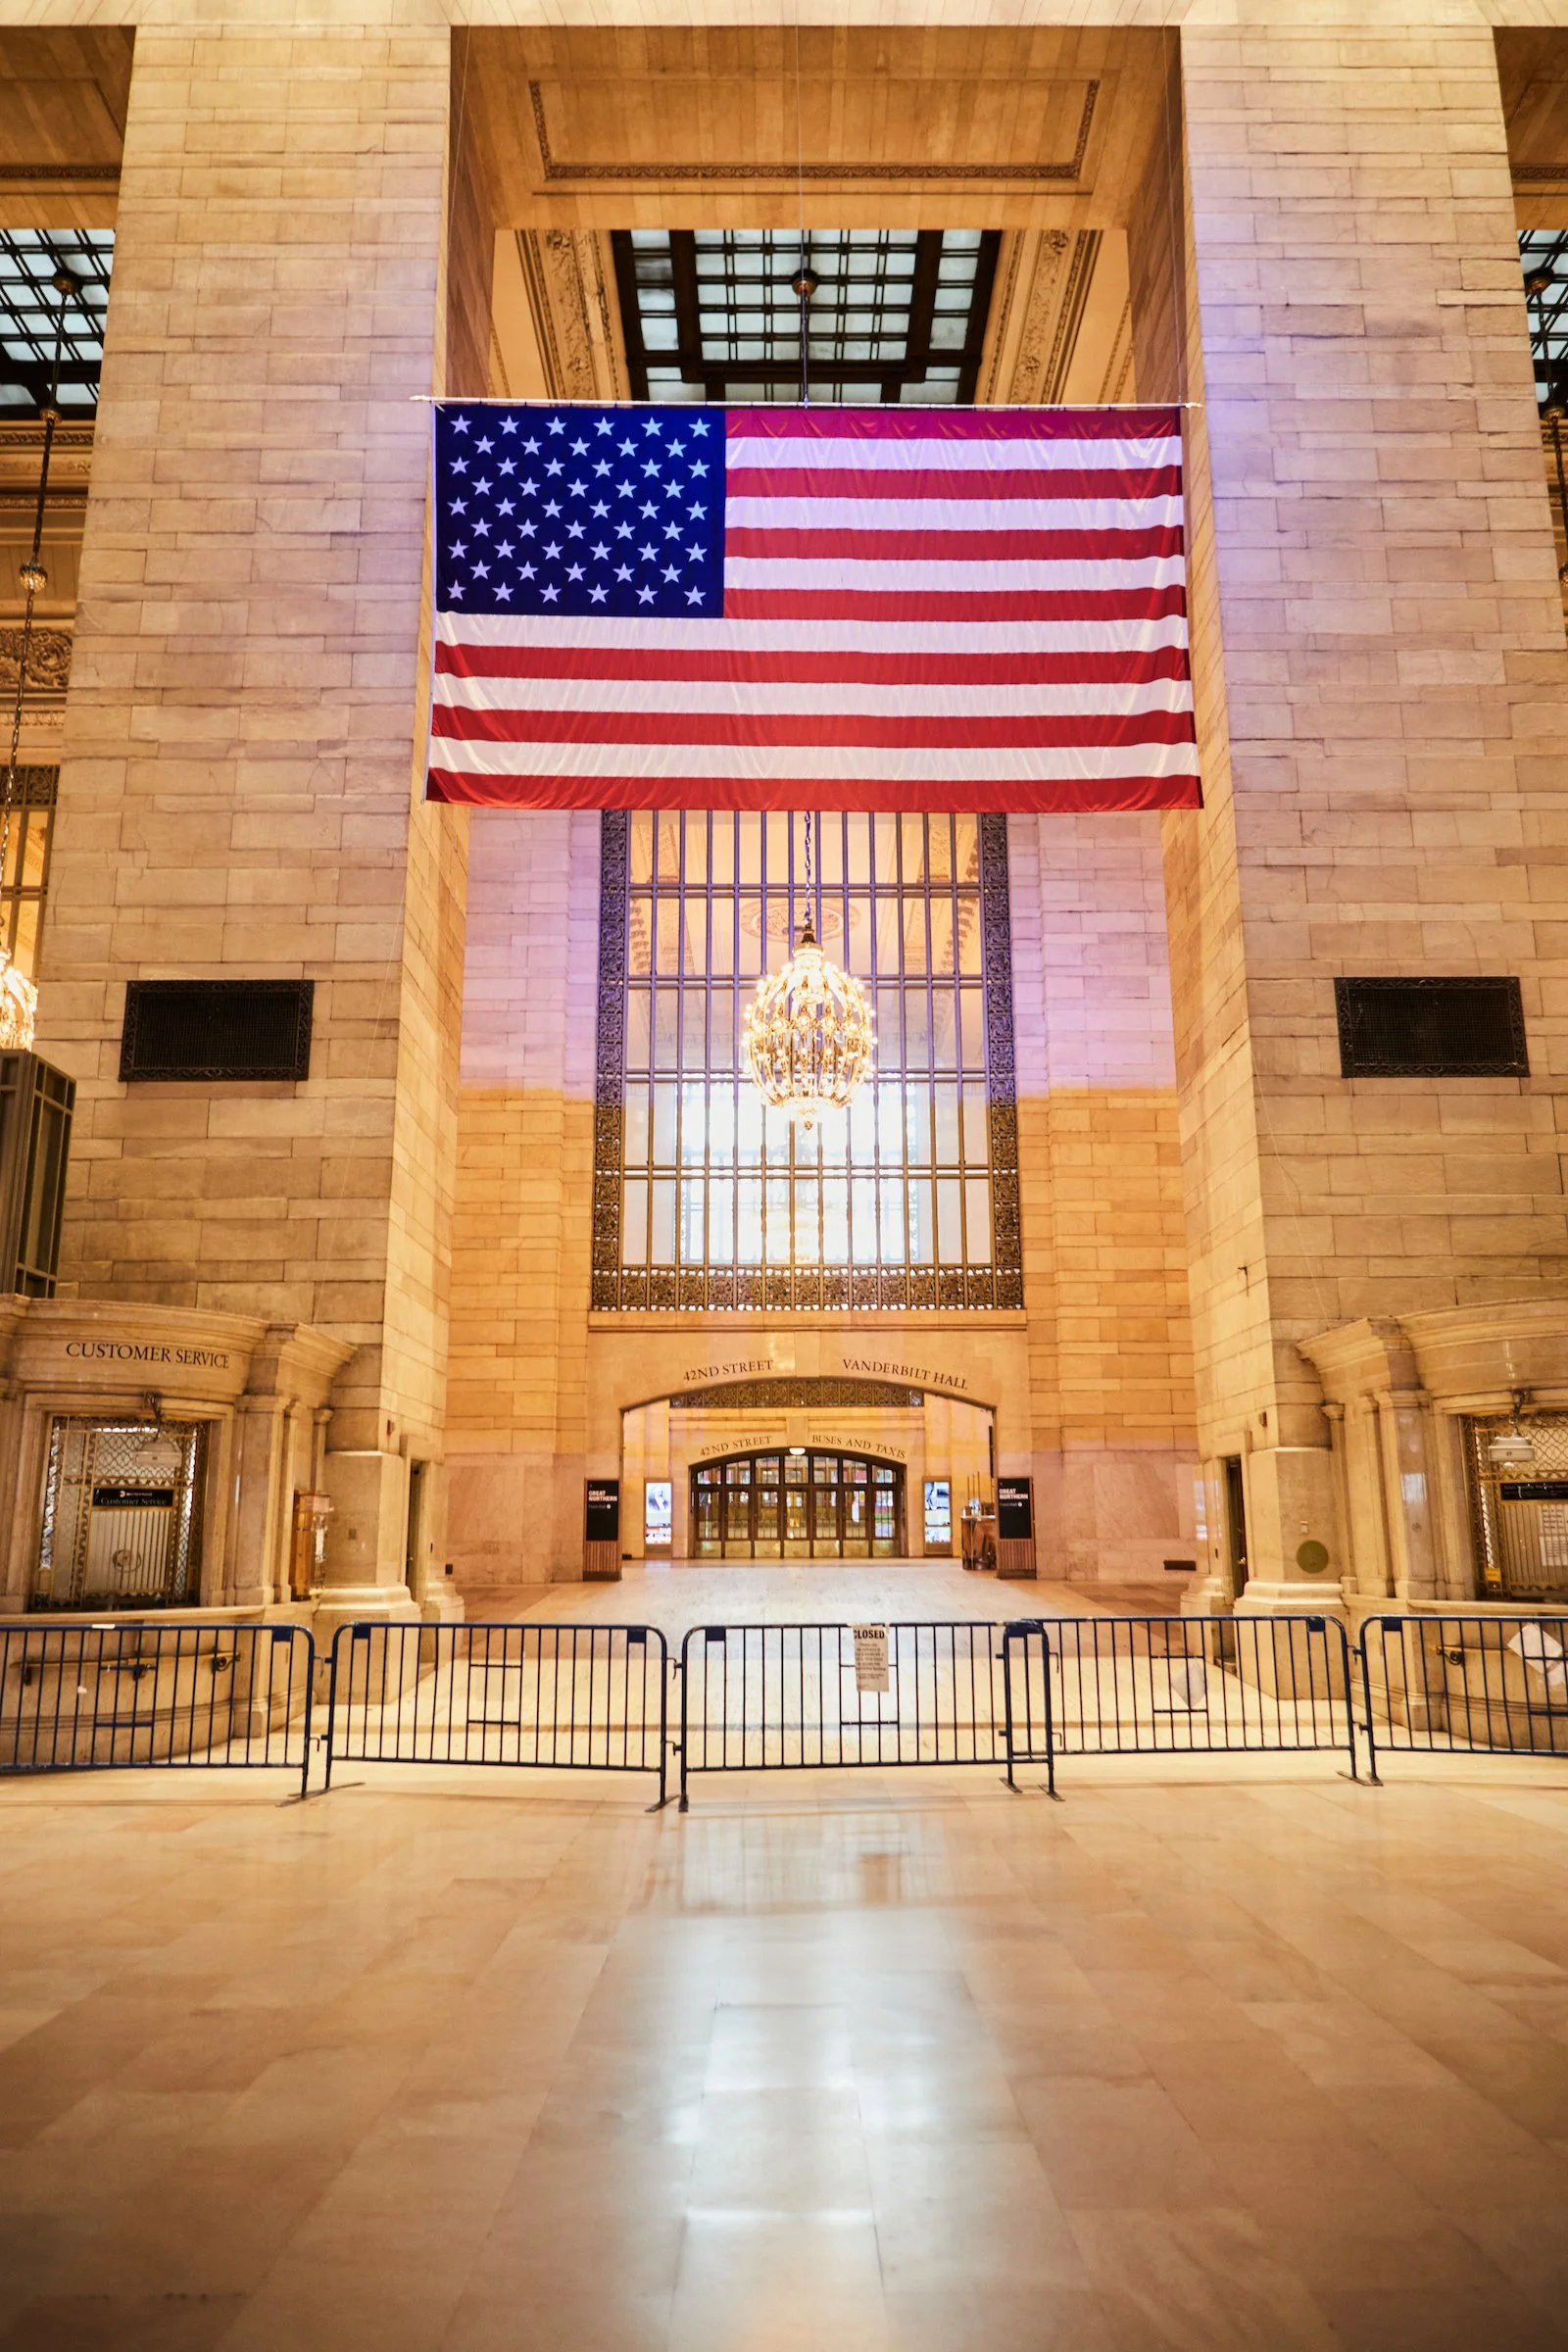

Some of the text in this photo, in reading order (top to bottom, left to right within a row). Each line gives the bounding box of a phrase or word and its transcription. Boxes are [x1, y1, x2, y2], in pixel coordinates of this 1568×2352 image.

[66, 1342, 230, 1369] CUSTOMER SERVICE
[683, 1359, 774, 1381] 42ND STREET
[842, 1358, 968, 1390] VANDERBILT HALL
[732, 1435, 772, 1448] STREET
[812, 1434, 906, 1459] BUSES AND TAXIS
